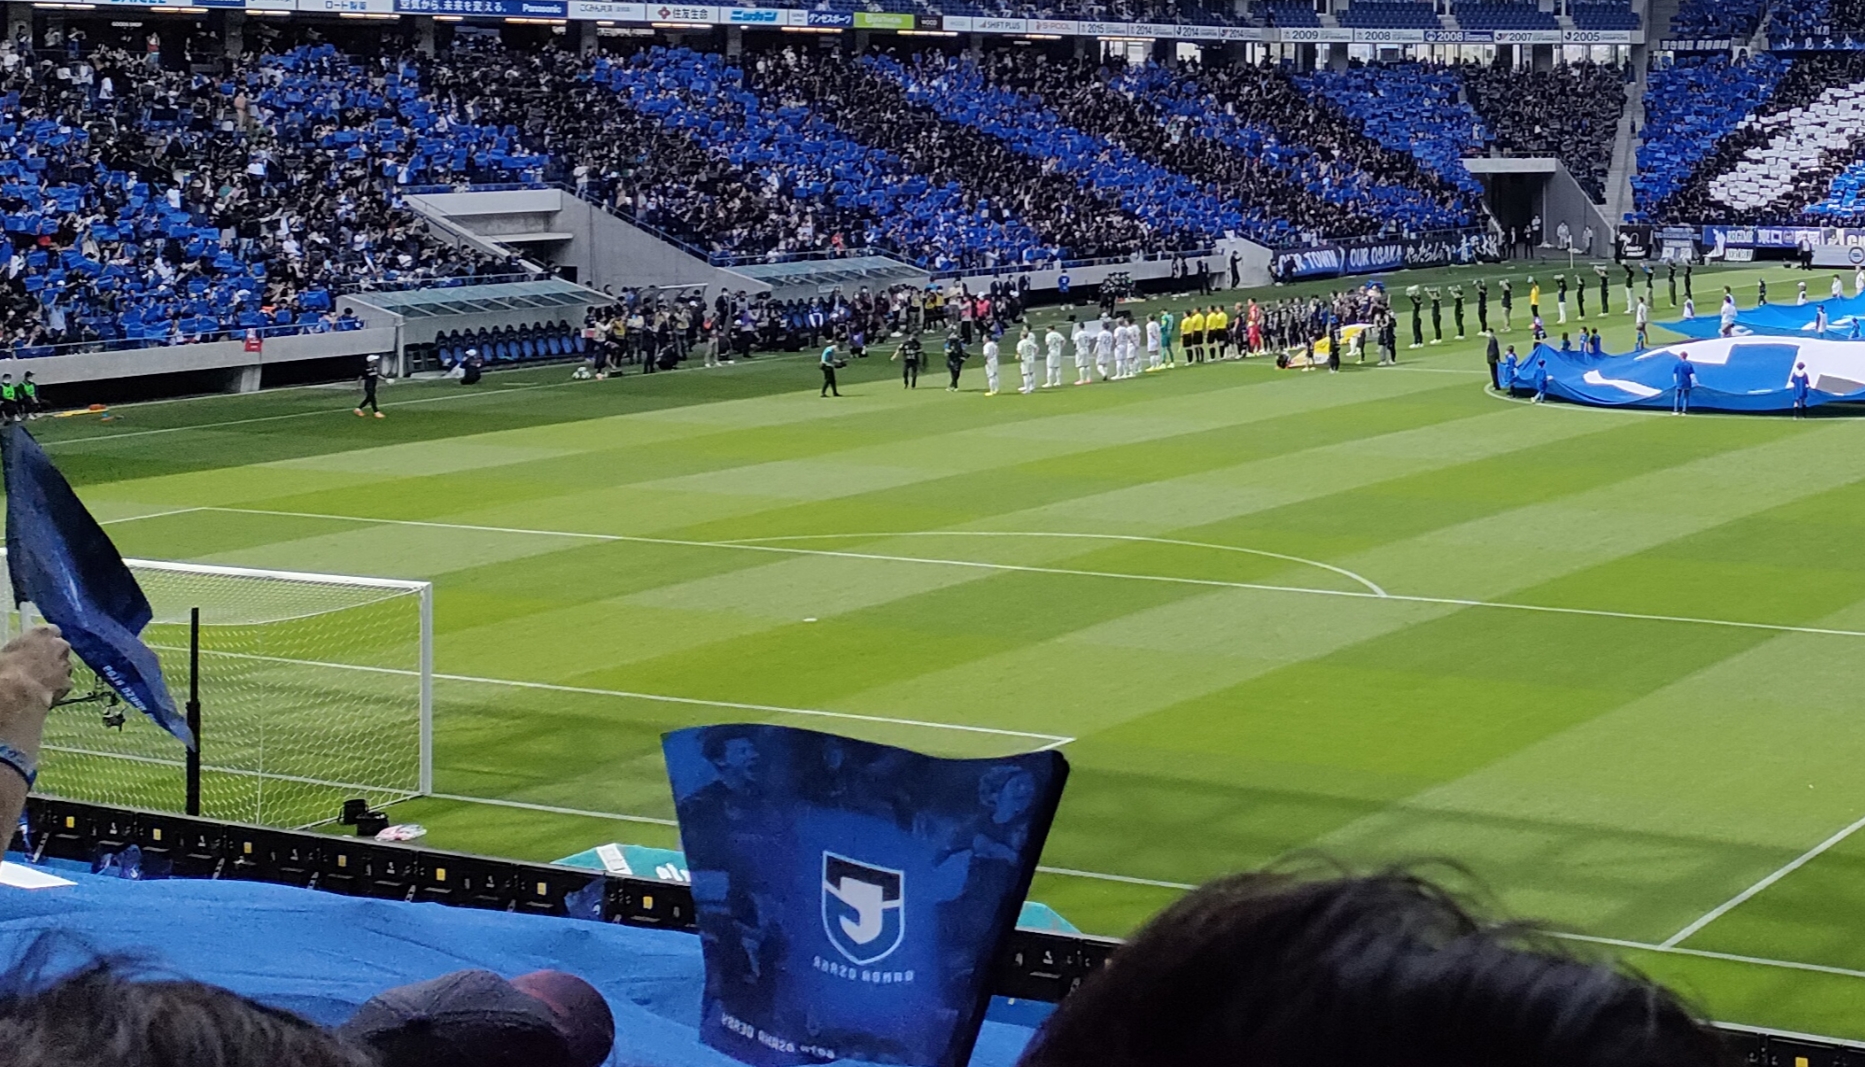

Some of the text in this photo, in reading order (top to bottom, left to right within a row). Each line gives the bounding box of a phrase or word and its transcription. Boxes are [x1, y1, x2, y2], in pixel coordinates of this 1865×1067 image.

[522, 3, 562, 14] Panasonic
[673, 8, 708, 20] 住友生命
[730, 10, 778, 22] ニッカン
[1087, 23, 1104, 34] 2015
[1135, 25, 1151, 35] 2014
[1291, 29, 1318, 40] 2009
[1364, 31, 1391, 41] 2008
[1436, 31, 1463, 42] 2008
[1508, 32, 1532, 42] 2007
[1572, 32, 1600, 42] 2005
[1350, 248, 1369, 267] OUR
[1371, 245, 1401, 266] OSAKA
